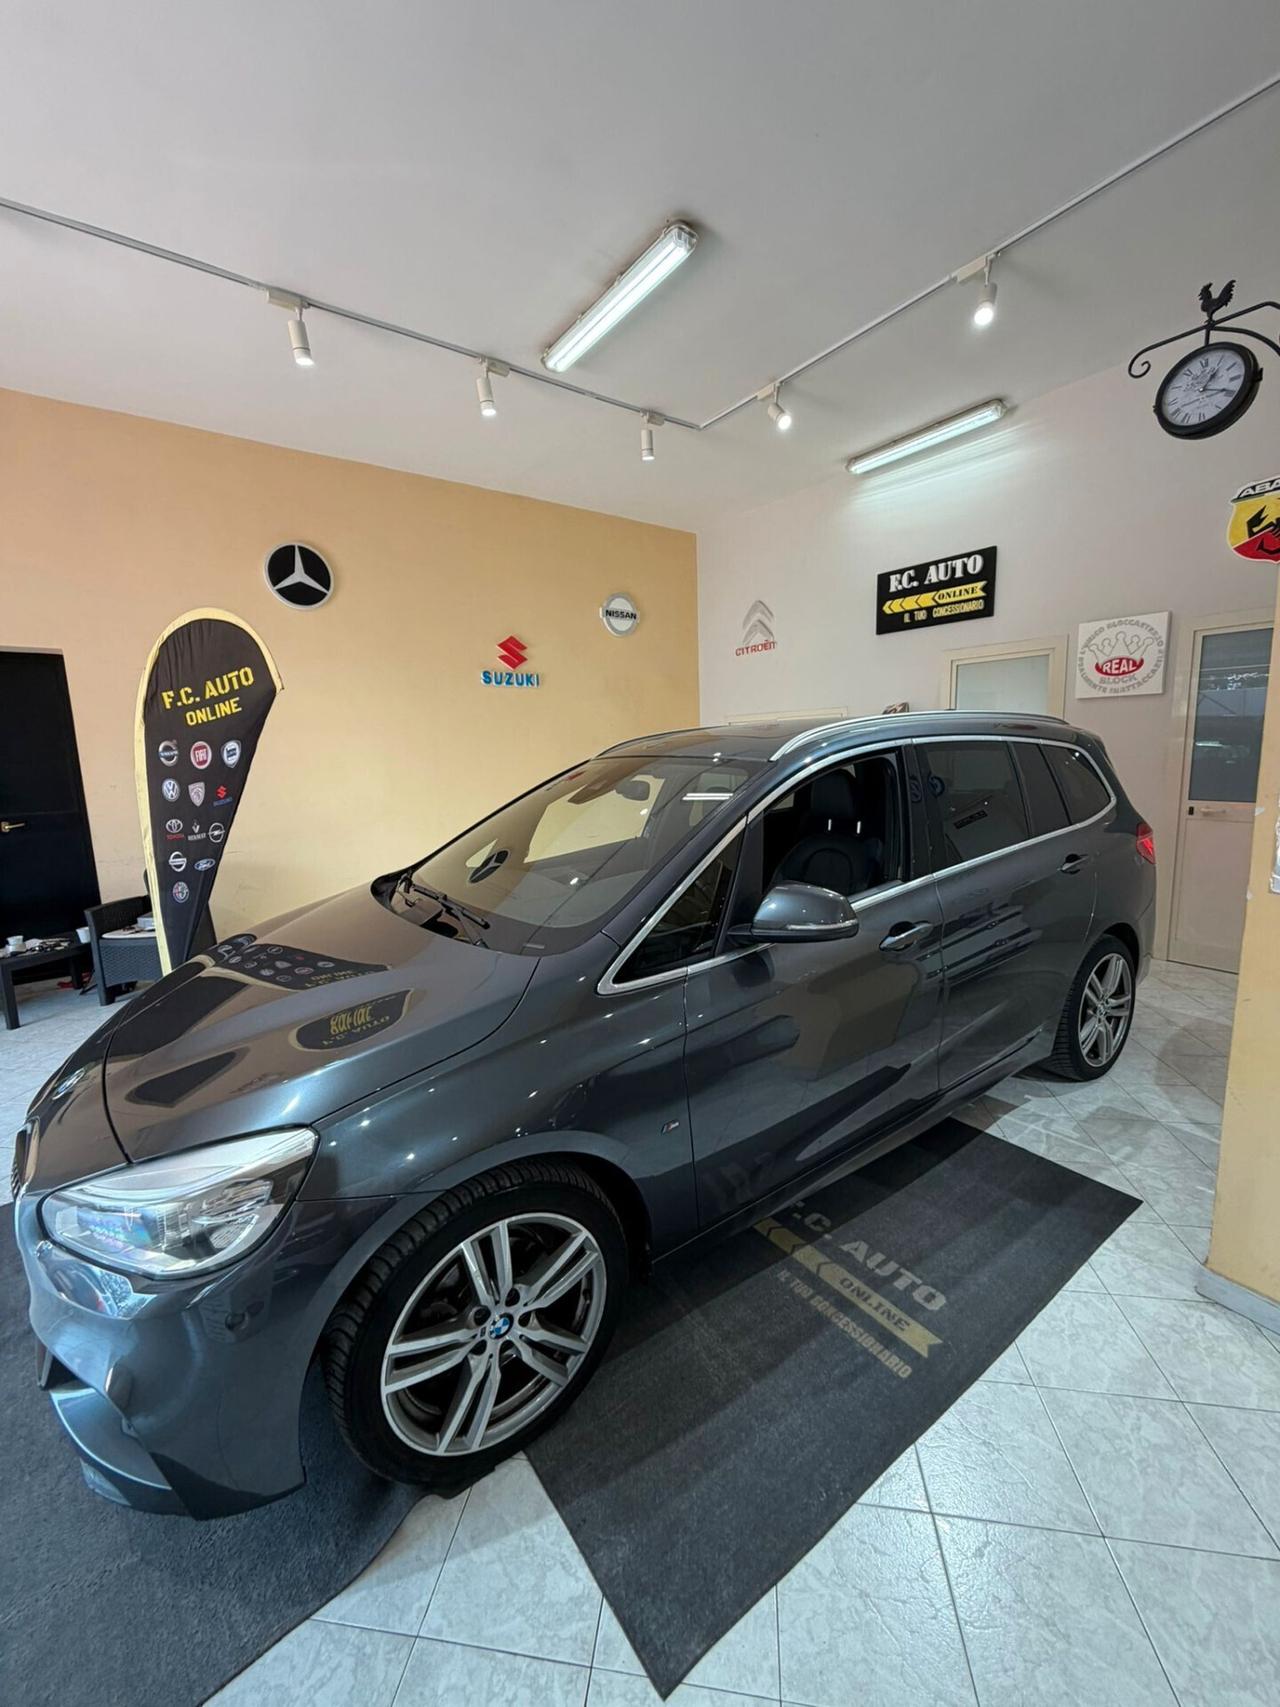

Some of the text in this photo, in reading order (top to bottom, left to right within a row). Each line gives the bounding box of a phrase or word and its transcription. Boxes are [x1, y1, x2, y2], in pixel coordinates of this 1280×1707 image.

[889, 554, 984, 592] F.C. AUTO
[937, 586, 978, 600] ONLINE
[605, 609, 637, 621] NISSAN
[481, 670, 540, 688] SUZUKI
[1102, 659, 1138, 674] REAL
[161, 666, 255, 709] F.C. AUTO
[185, 697, 242, 726] ONLINE
[839, 1240, 946, 1311] AUTO
[839, 1276, 910, 1332] ONLINE
[790, 1279, 814, 1299] TUO
[811, 1295, 913, 1379] CONCESSIONARIO
